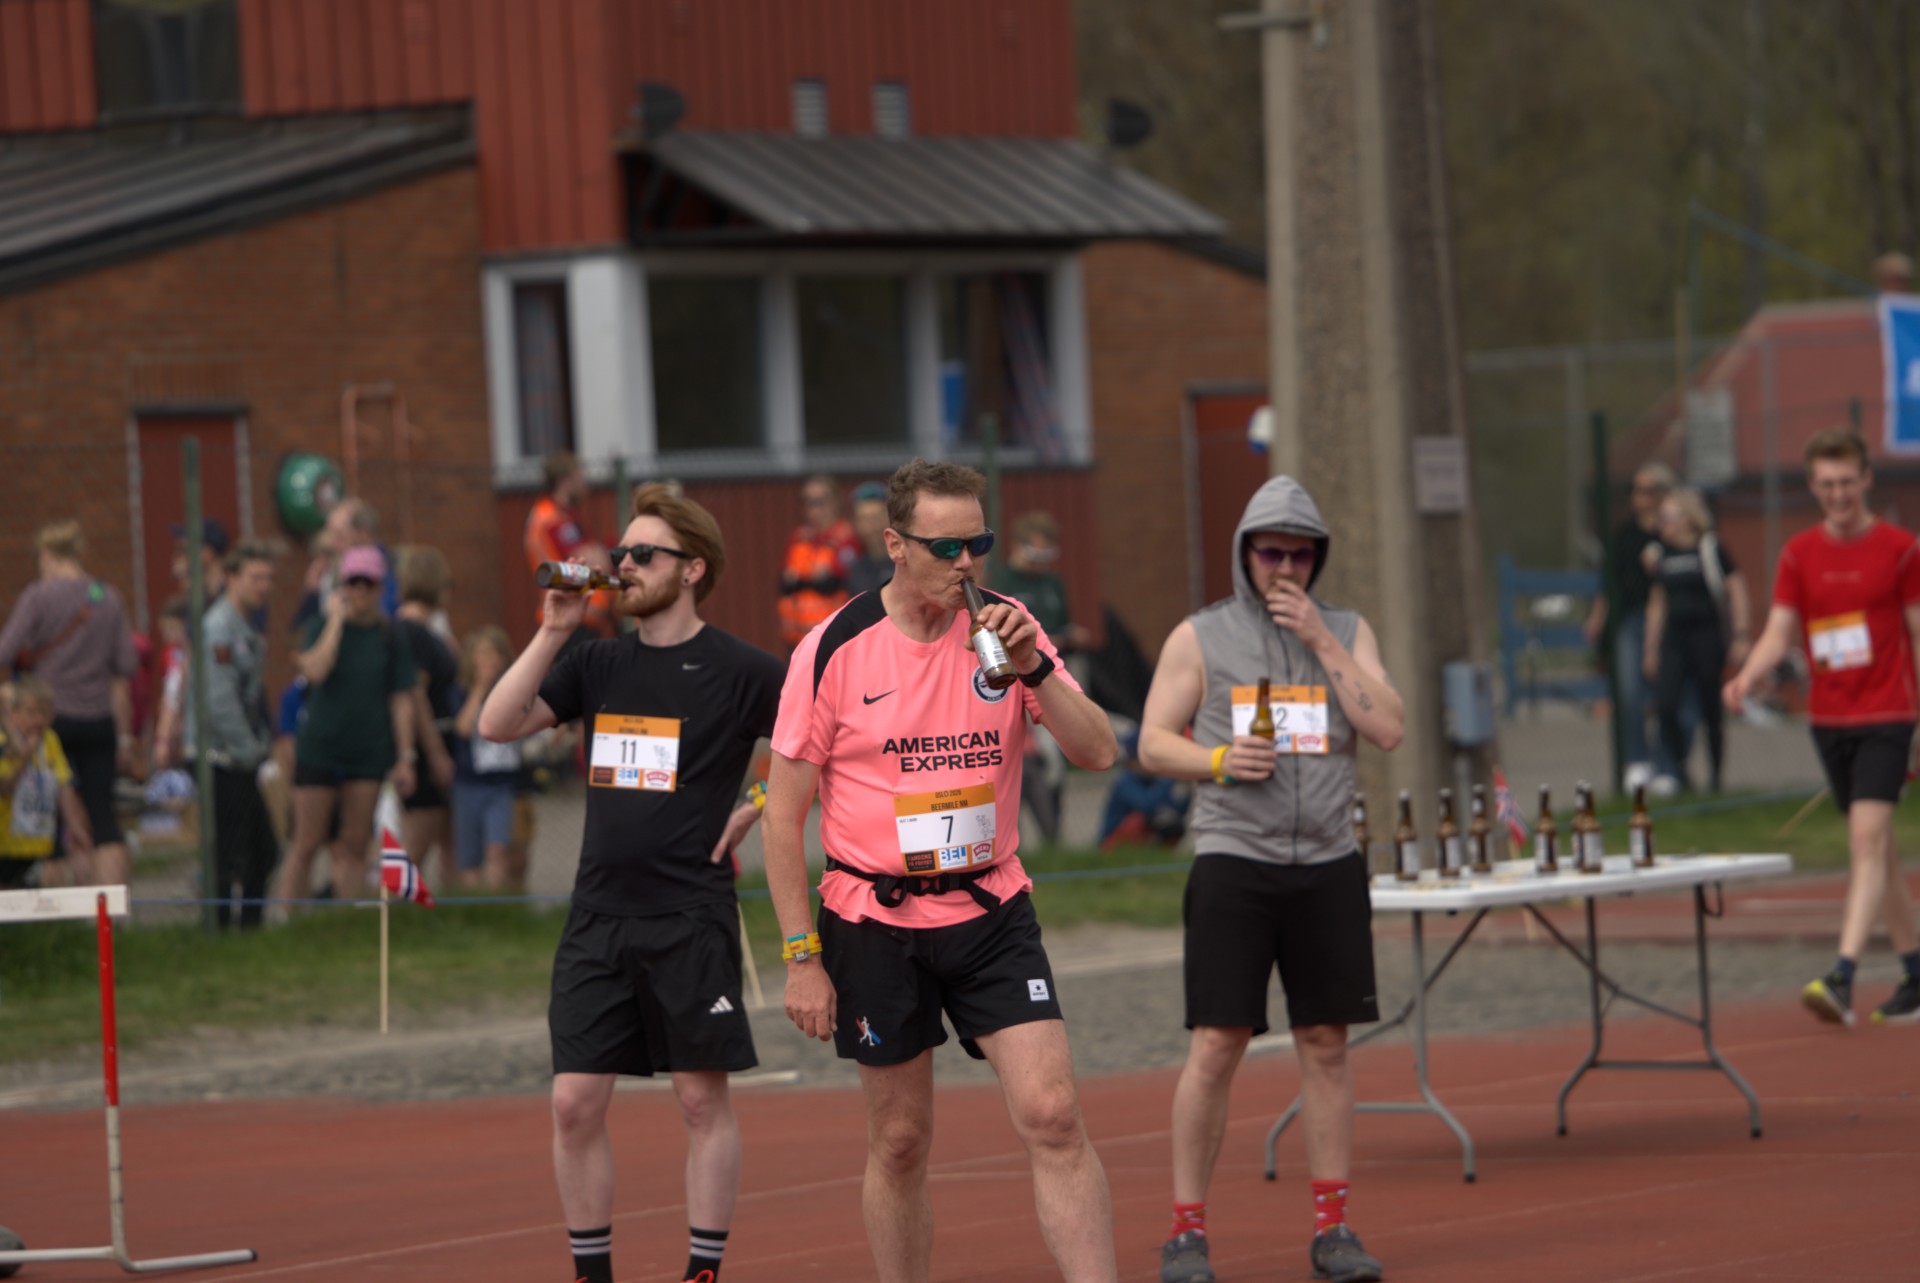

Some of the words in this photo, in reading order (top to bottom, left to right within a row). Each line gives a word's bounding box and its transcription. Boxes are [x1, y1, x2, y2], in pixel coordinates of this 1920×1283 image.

[620, 739, 637, 764] 11
[882, 730, 1000, 754] AMERICAN
[900, 749, 1003, 773] EXPRESS
[931, 800, 959, 811] BEERMILE
[935, 790, 949, 799] OSLO
[941, 815, 953, 844] 7
